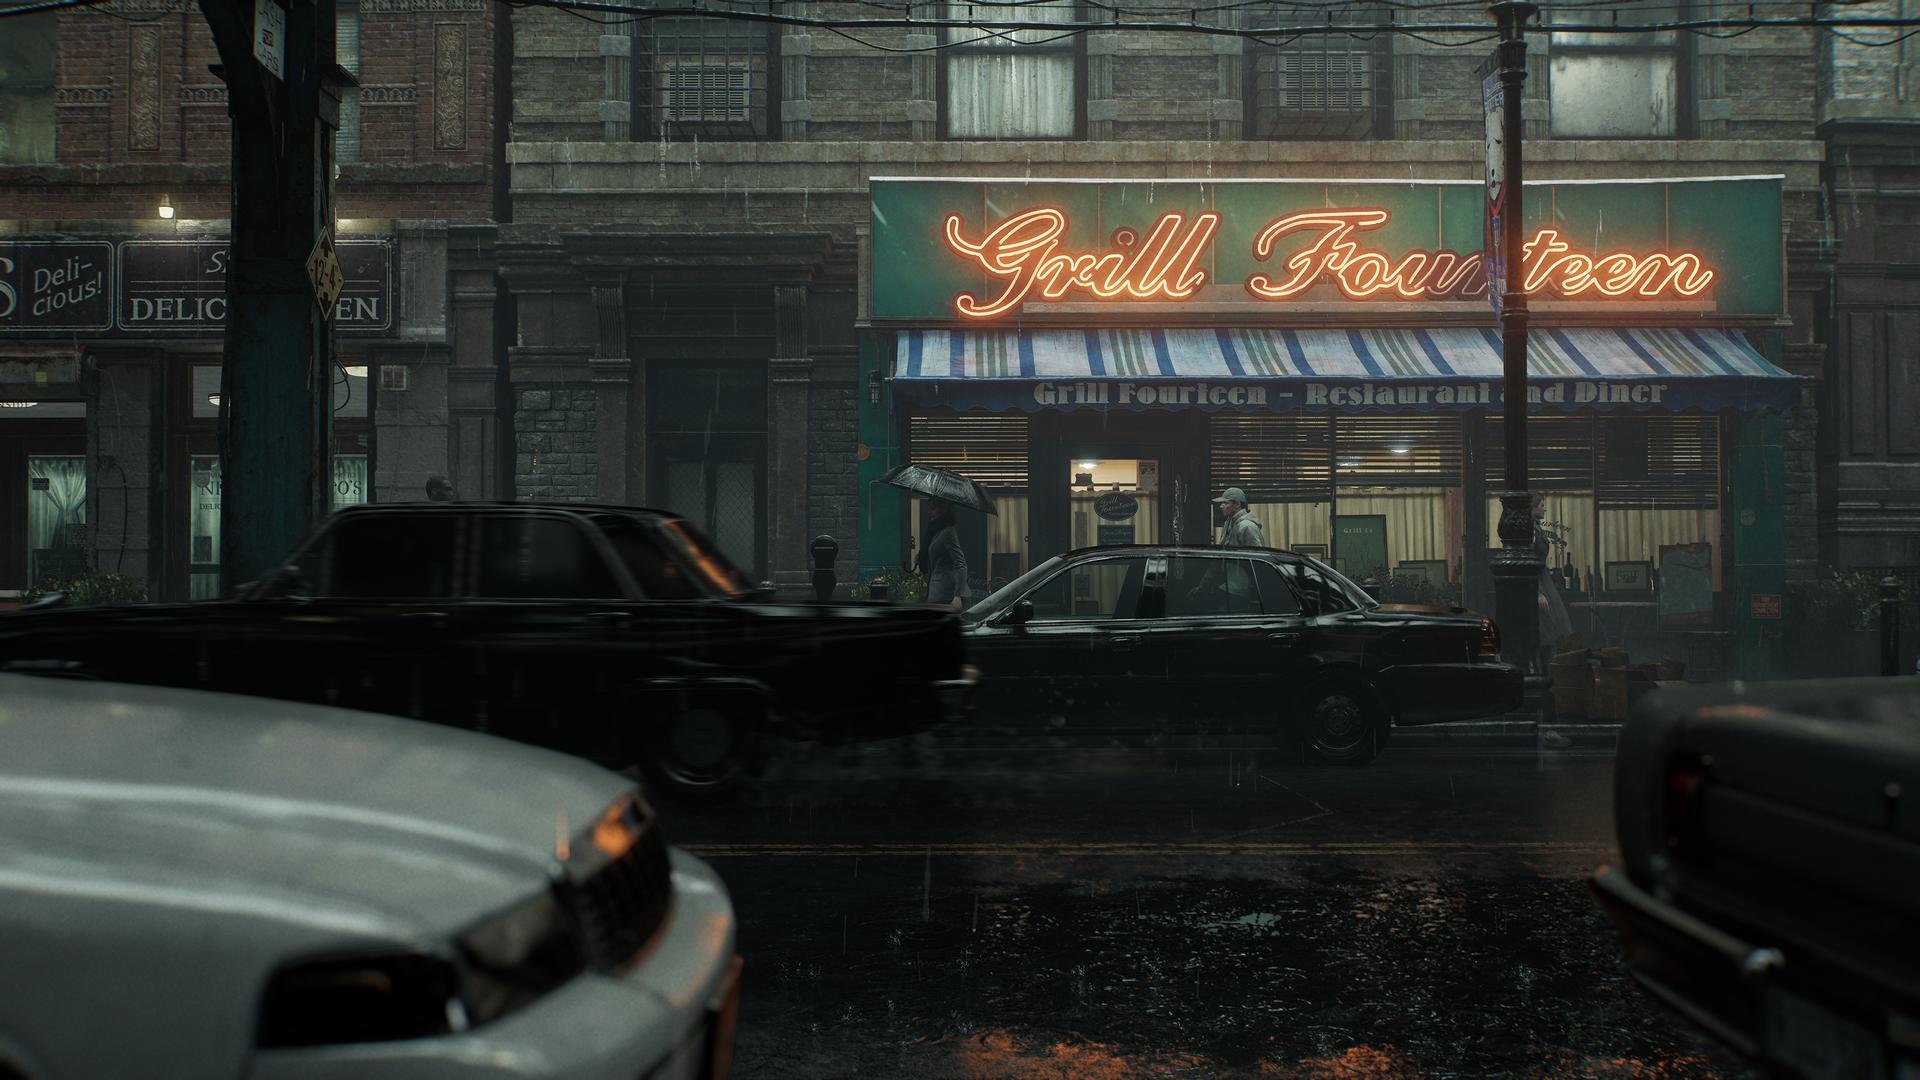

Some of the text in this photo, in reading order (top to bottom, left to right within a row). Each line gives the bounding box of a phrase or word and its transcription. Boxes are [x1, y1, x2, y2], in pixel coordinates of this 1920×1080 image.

[33, 256, 93, 293] Deli-
[945, 207, 1219, 317] Grill
[32, 271, 103, 316] cious!
[1033, 382, 1110, 405] Grill
[1118, 382, 1268, 405] Fourteen
[1304, 382, 1491, 406] Restaurant
[1499, 382, 1566, 404] nd
[1574, 381, 1668, 404] Diner
